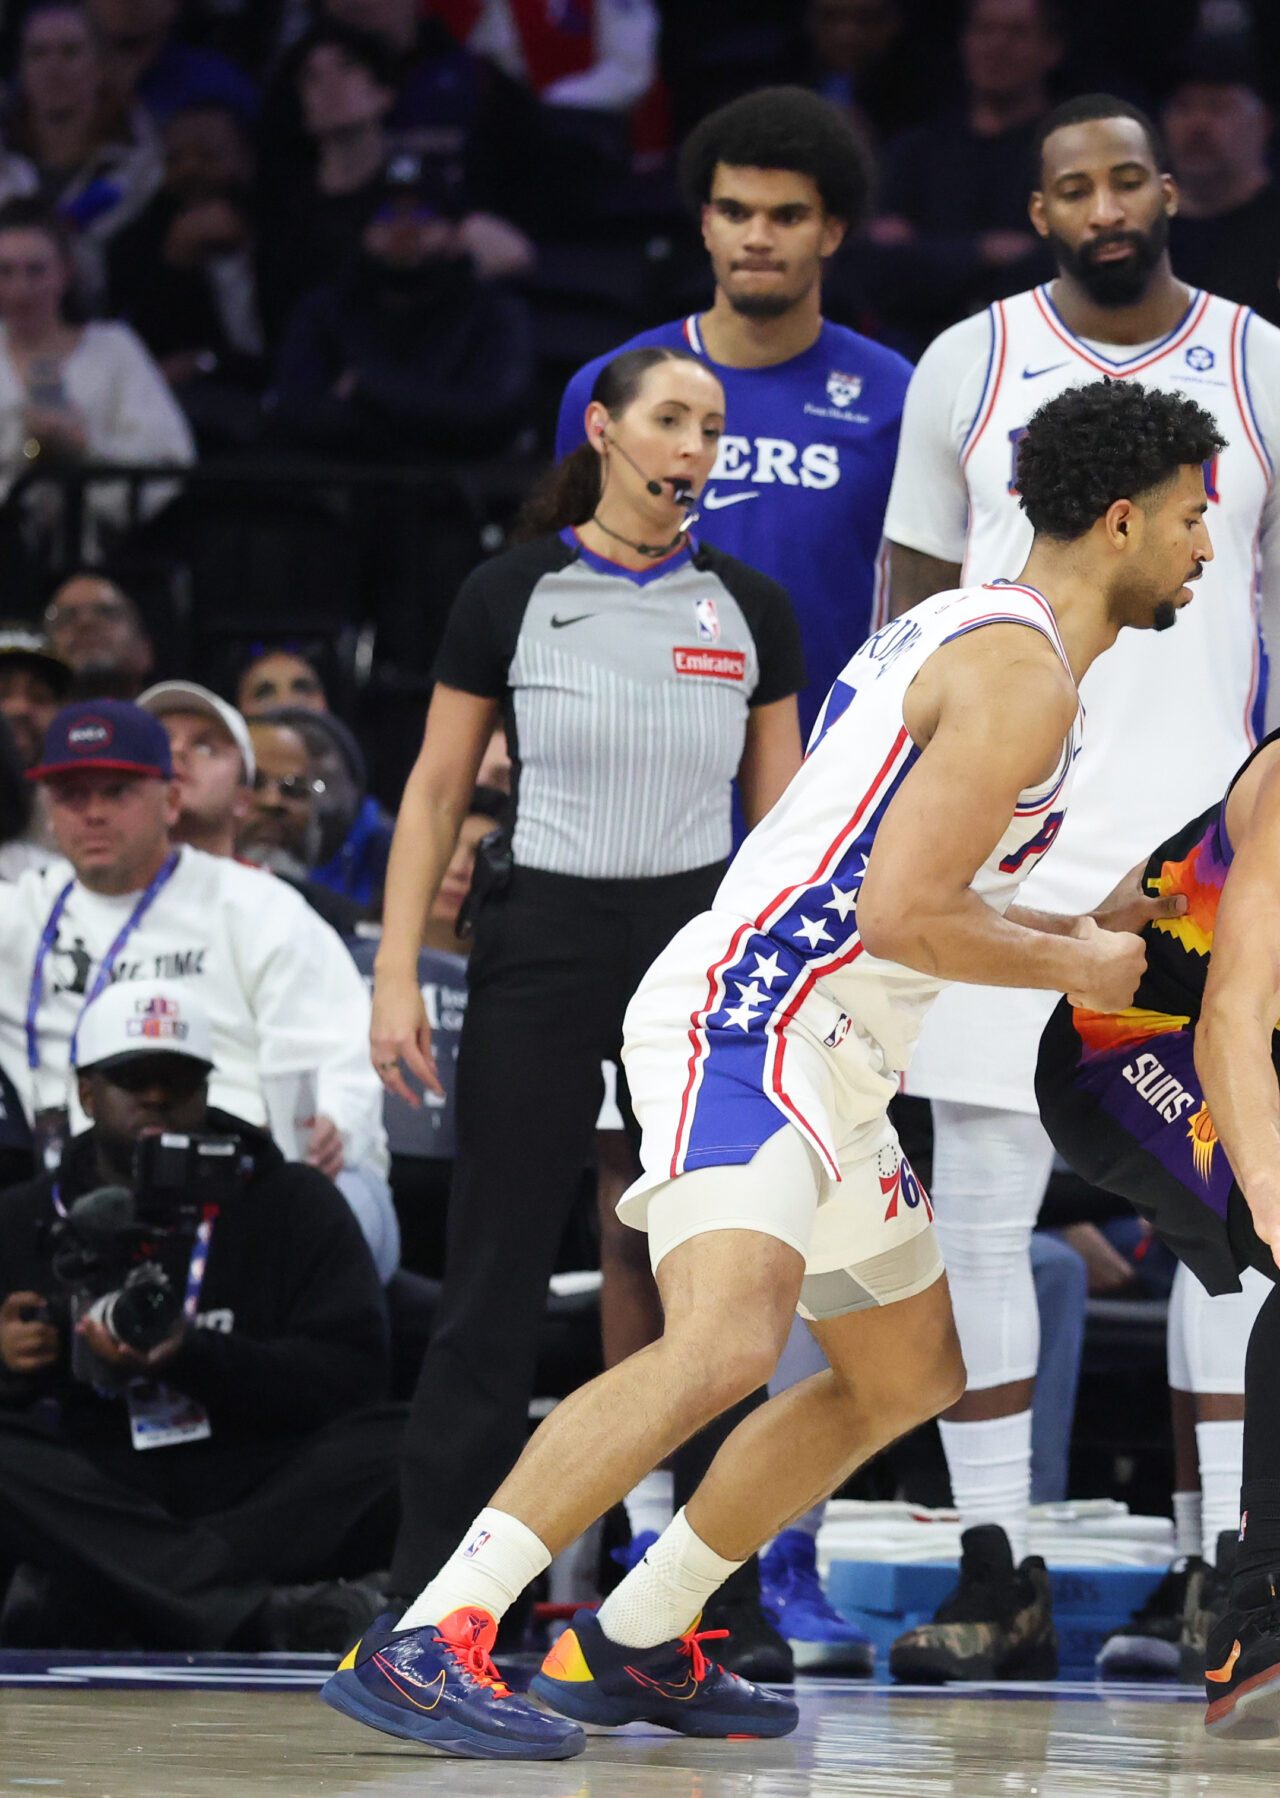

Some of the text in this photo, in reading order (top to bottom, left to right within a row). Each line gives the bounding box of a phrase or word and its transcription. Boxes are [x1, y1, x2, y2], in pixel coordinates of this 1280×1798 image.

[675, 651, 743, 675] Emirates
[1122, 1053, 1196, 1124] SUNS
[879, 1156, 920, 1223] 76
